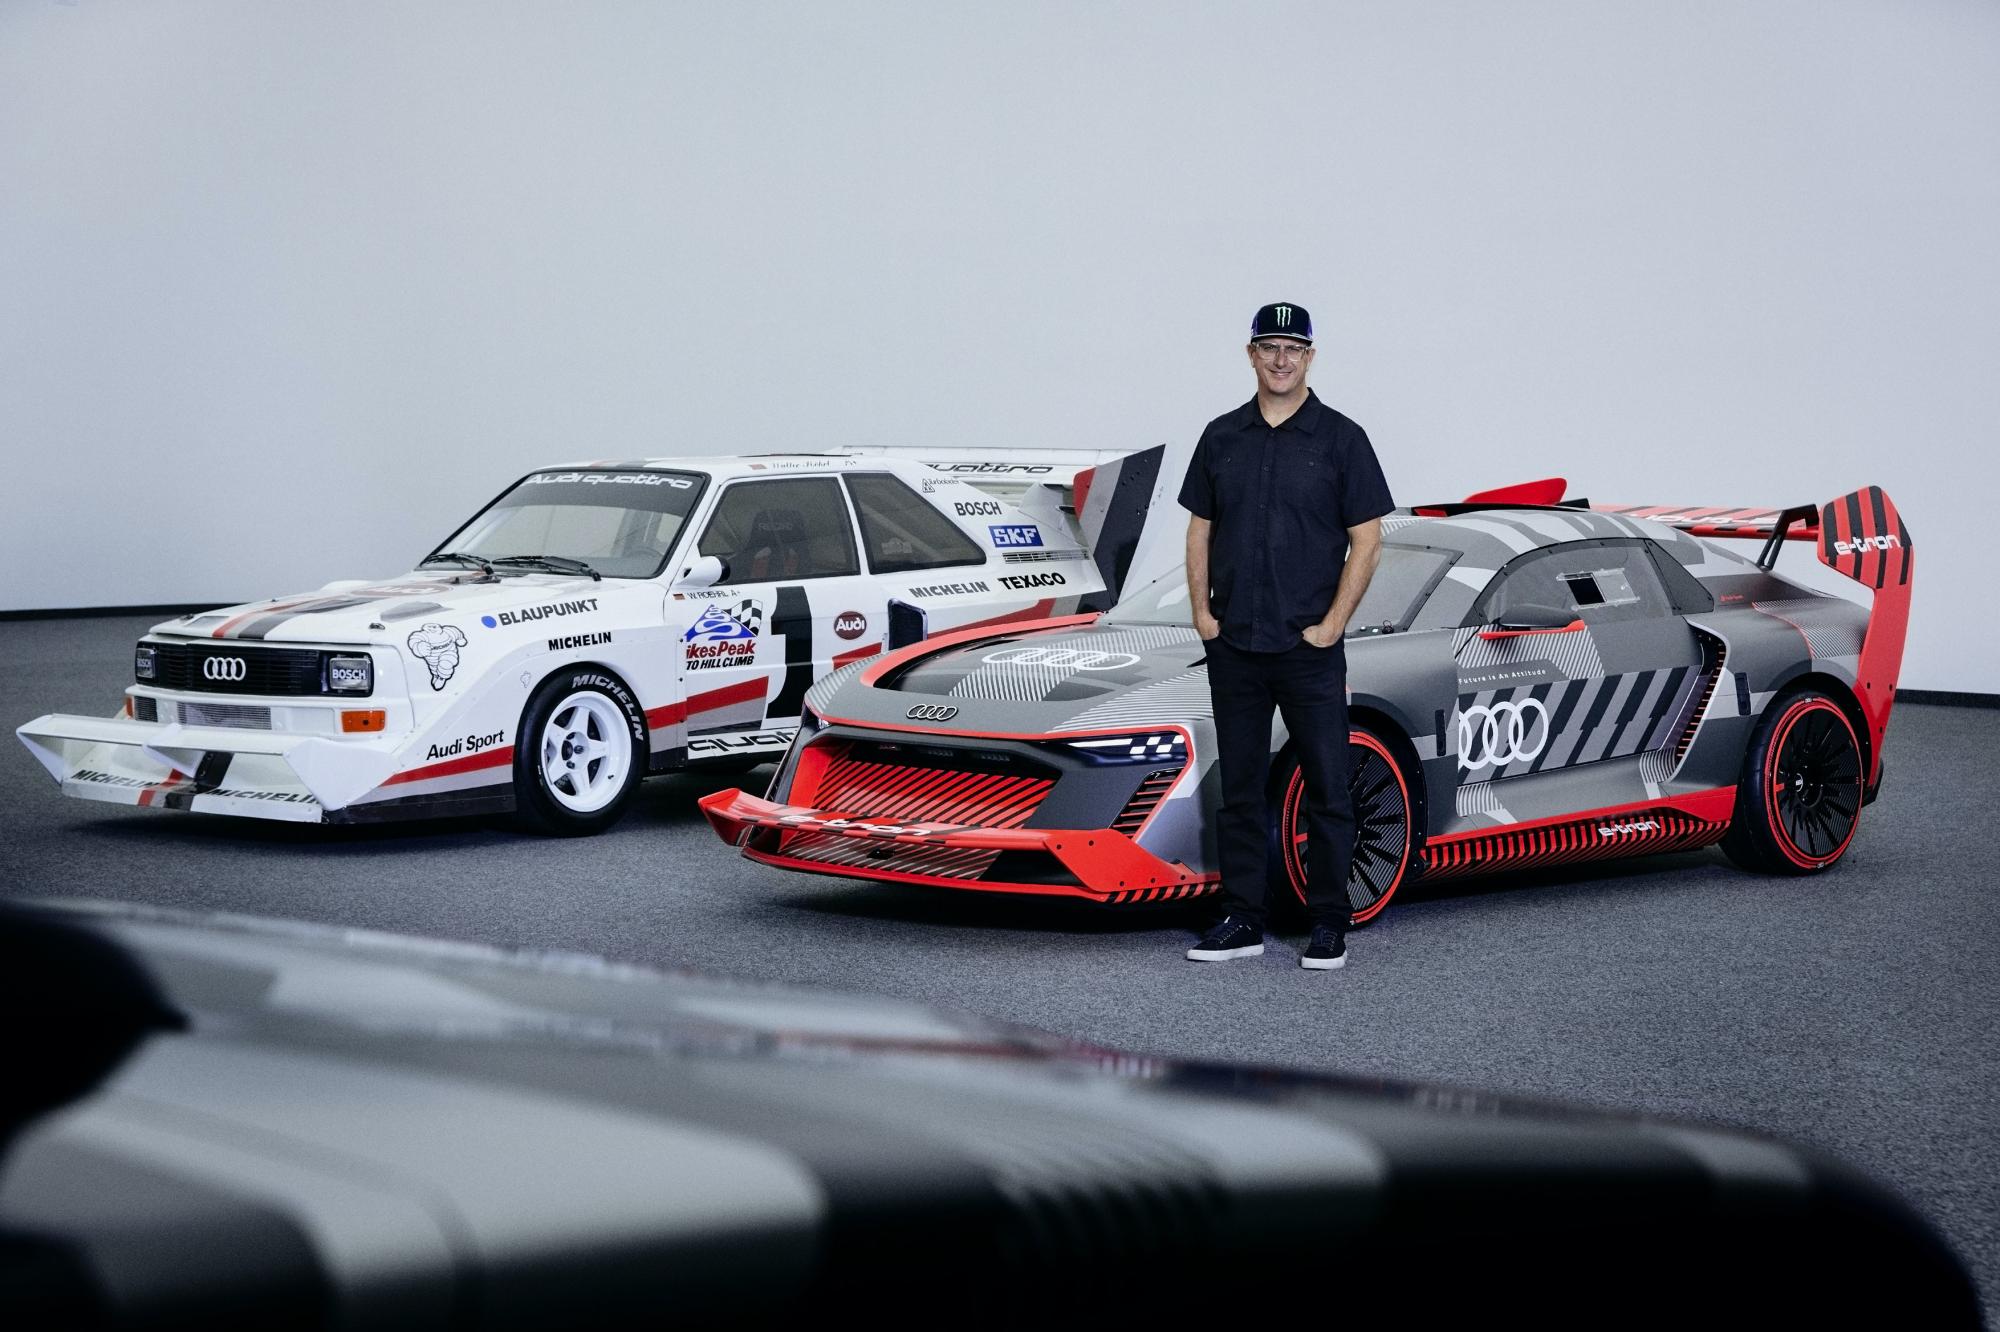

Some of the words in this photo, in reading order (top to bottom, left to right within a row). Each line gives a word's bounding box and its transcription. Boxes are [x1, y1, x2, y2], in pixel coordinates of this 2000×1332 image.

[925, 462, 1054, 474] uattro
[522, 472, 582, 486] Audi
[582, 474, 693, 490] quattro
[954, 501, 1002, 516] BOSCH
[995, 527, 1037, 545] SKF
[1833, 534, 1901, 556] e-tron
[908, 581, 990, 599] MICHELIN
[998, 572, 1067, 590] TEXACO
[498, 598, 598, 626] BLAUPUNKT
[835, 617, 866, 632] Audi
[548, 631, 612, 651] MICHELIN
[766, 586, 814, 719] 1
[700, 658, 721, 670] HILL
[722, 655, 755, 668] CLIMB
[332, 668, 367, 681] BOSCH
[1458, 675, 1487, 685] Future
[1511, 668, 1547, 679] Attitude
[571, 674, 644, 742] MICHELIN
[426, 738, 462, 761] Audi
[466, 729, 504, 753] Sport
[688, 730, 797, 752] quat
[779, 815, 932, 836] e-tron
[1597, 820, 1661, 837] e-tron
